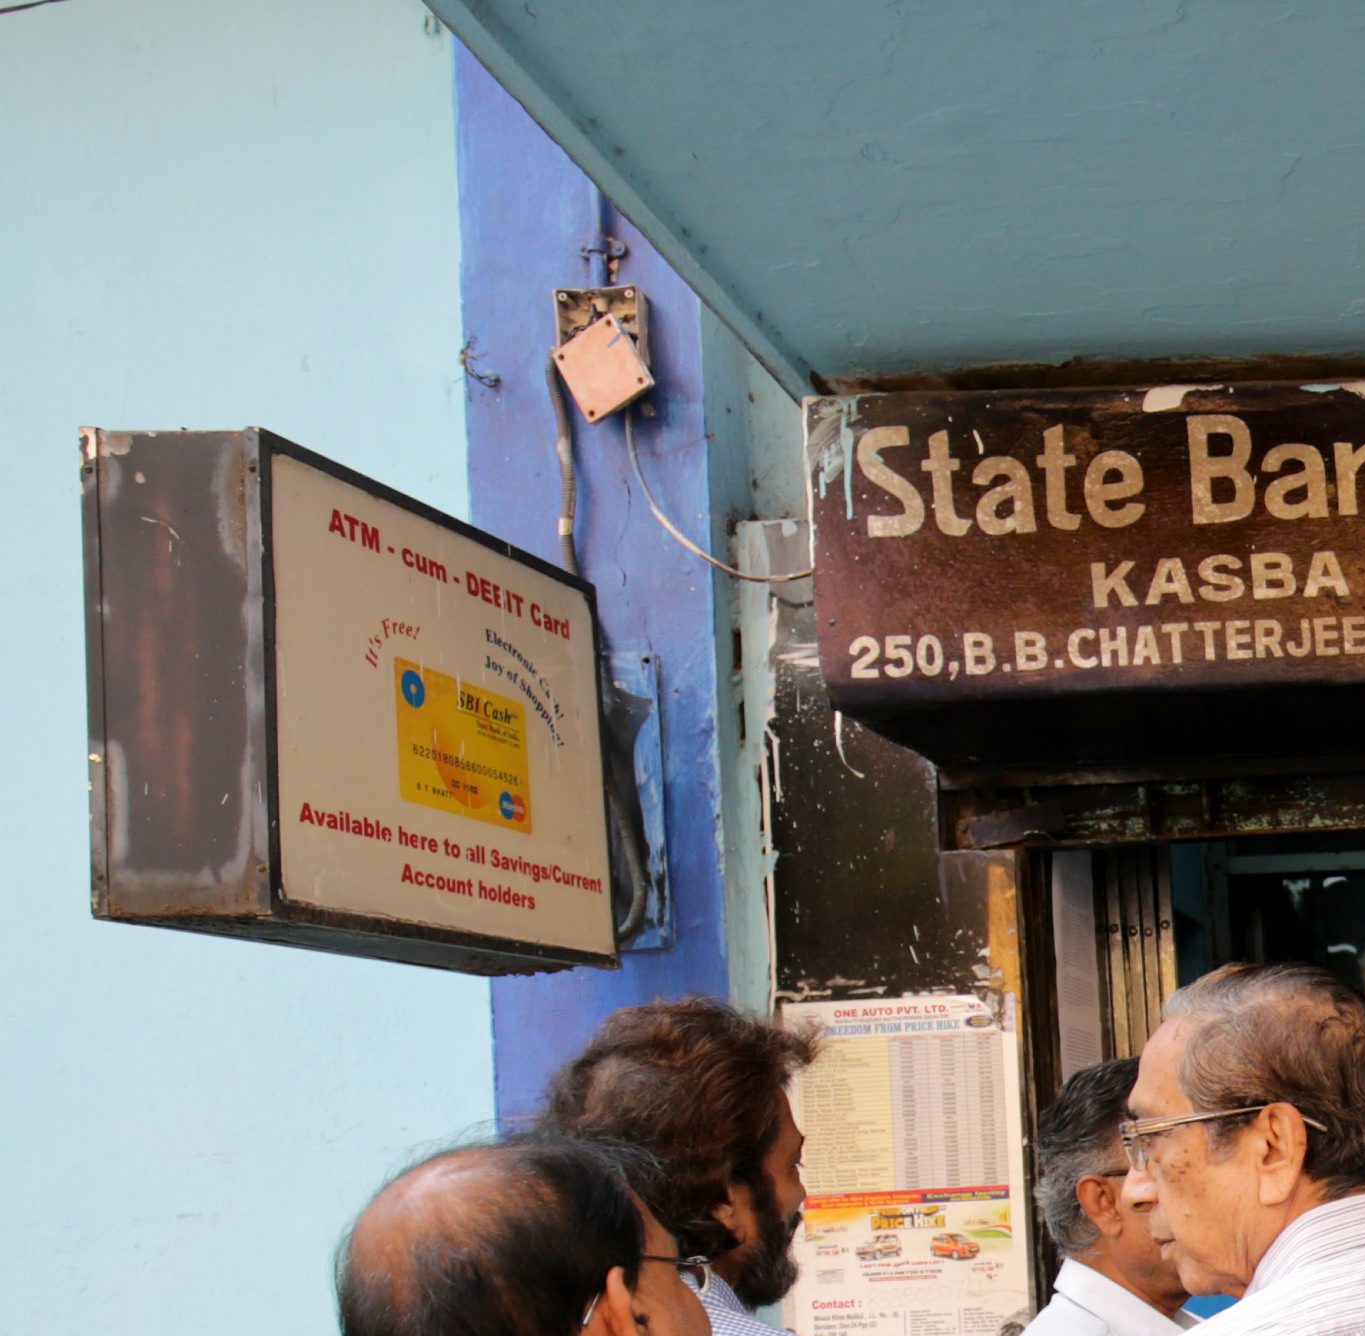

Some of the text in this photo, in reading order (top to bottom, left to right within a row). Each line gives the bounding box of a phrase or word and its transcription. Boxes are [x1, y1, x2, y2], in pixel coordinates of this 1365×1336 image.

[856, 423, 1146, 540] State
[329, 508, 380, 554] ATM
[402, 547, 448, 584] cum
[531, 603, 570, 641] Card
[1090, 550, 1350, 608] KASBA
[365, 618, 421, 669] It's Free!
[485, 629, 538, 679] Electronic
[485, 655, 504, 678] Joy
[507, 669, 518, 685] of
[483, 700, 513, 725] Cash
[299, 801, 603, 894] Available here to all Savings/Current
[401, 863, 536, 910] Account holders
[834, 1004, 949, 1019] ONE AUTO PVT. LTD.
[875, 1021, 901, 1035] FROM
[904, 1020, 934, 1033] PRICE
[936, 1018, 961, 1031] HIKE
[812, 1299, 856, 1310] Contact
